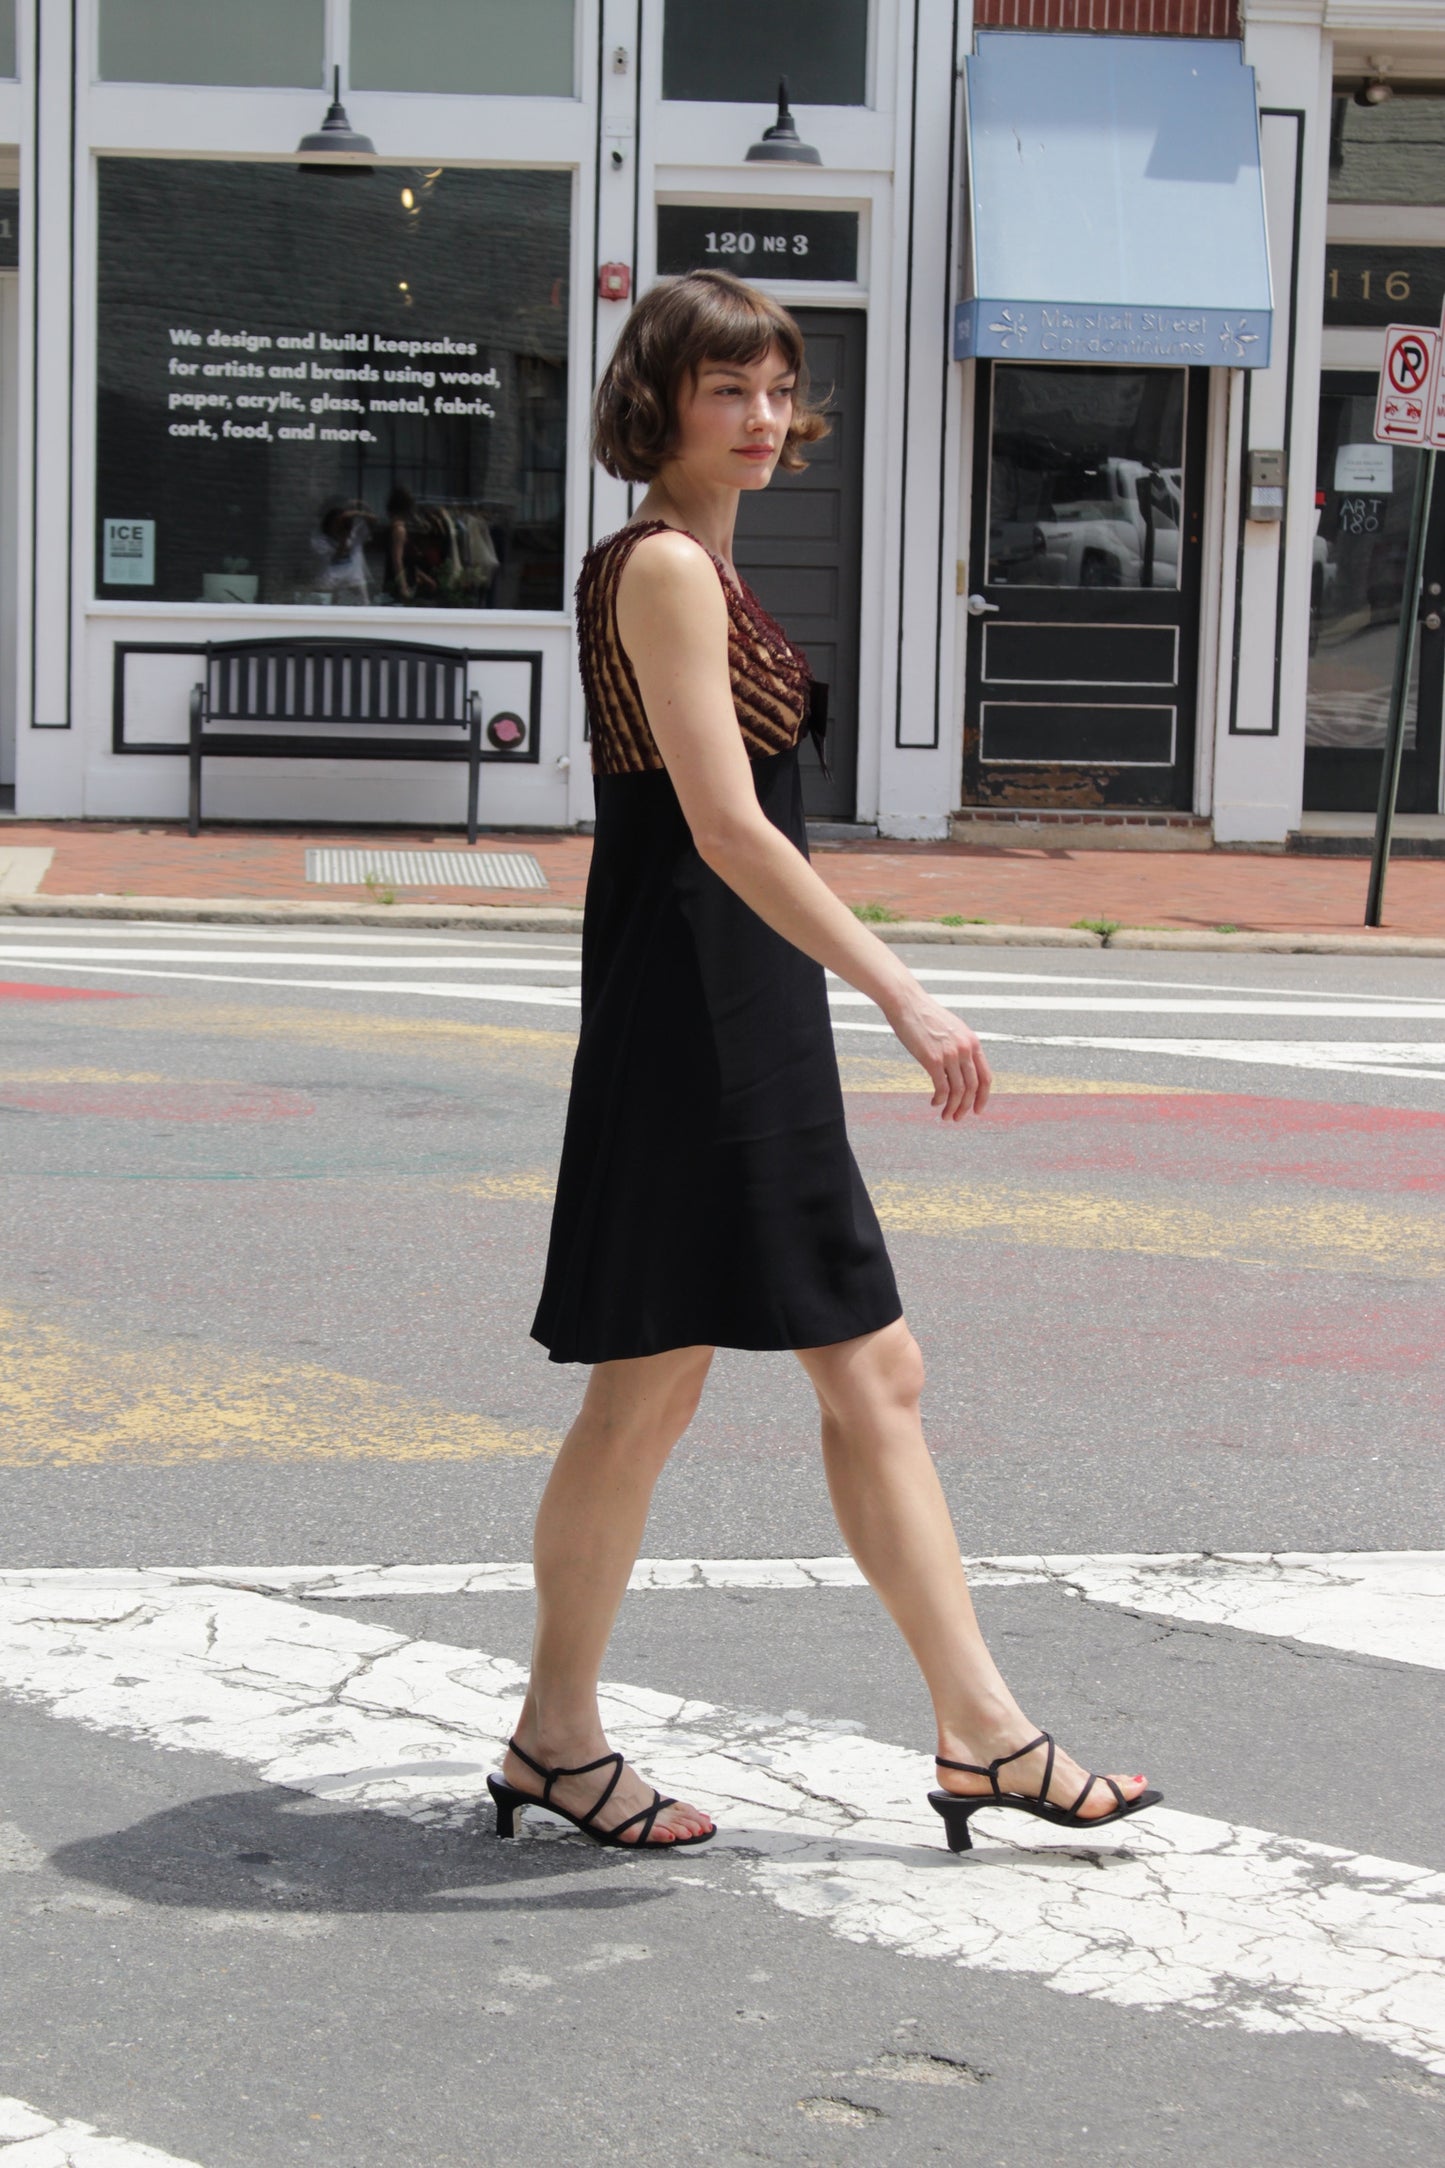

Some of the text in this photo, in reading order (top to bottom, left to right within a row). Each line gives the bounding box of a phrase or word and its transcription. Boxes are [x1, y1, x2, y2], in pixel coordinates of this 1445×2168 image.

[705, 231, 756, 254] 120
[792, 234, 809, 255] 3
[1328, 268, 1411, 301] 116
[1041, 309, 1206, 334] Marshall Street
[168, 328, 478, 357] We design and build keepsakes
[1041, 331, 1206, 357] Condominiums
[168, 358, 501, 389] for artists and brands using wood,
[168, 391, 496, 418] paper, acrylic, glass, metal, fabric,
[168, 420, 378, 443] cork, food, and more.
[1340, 498, 1383, 517] ART
[110, 526, 144, 540] ICE
[1342, 513, 1379, 534] 180
